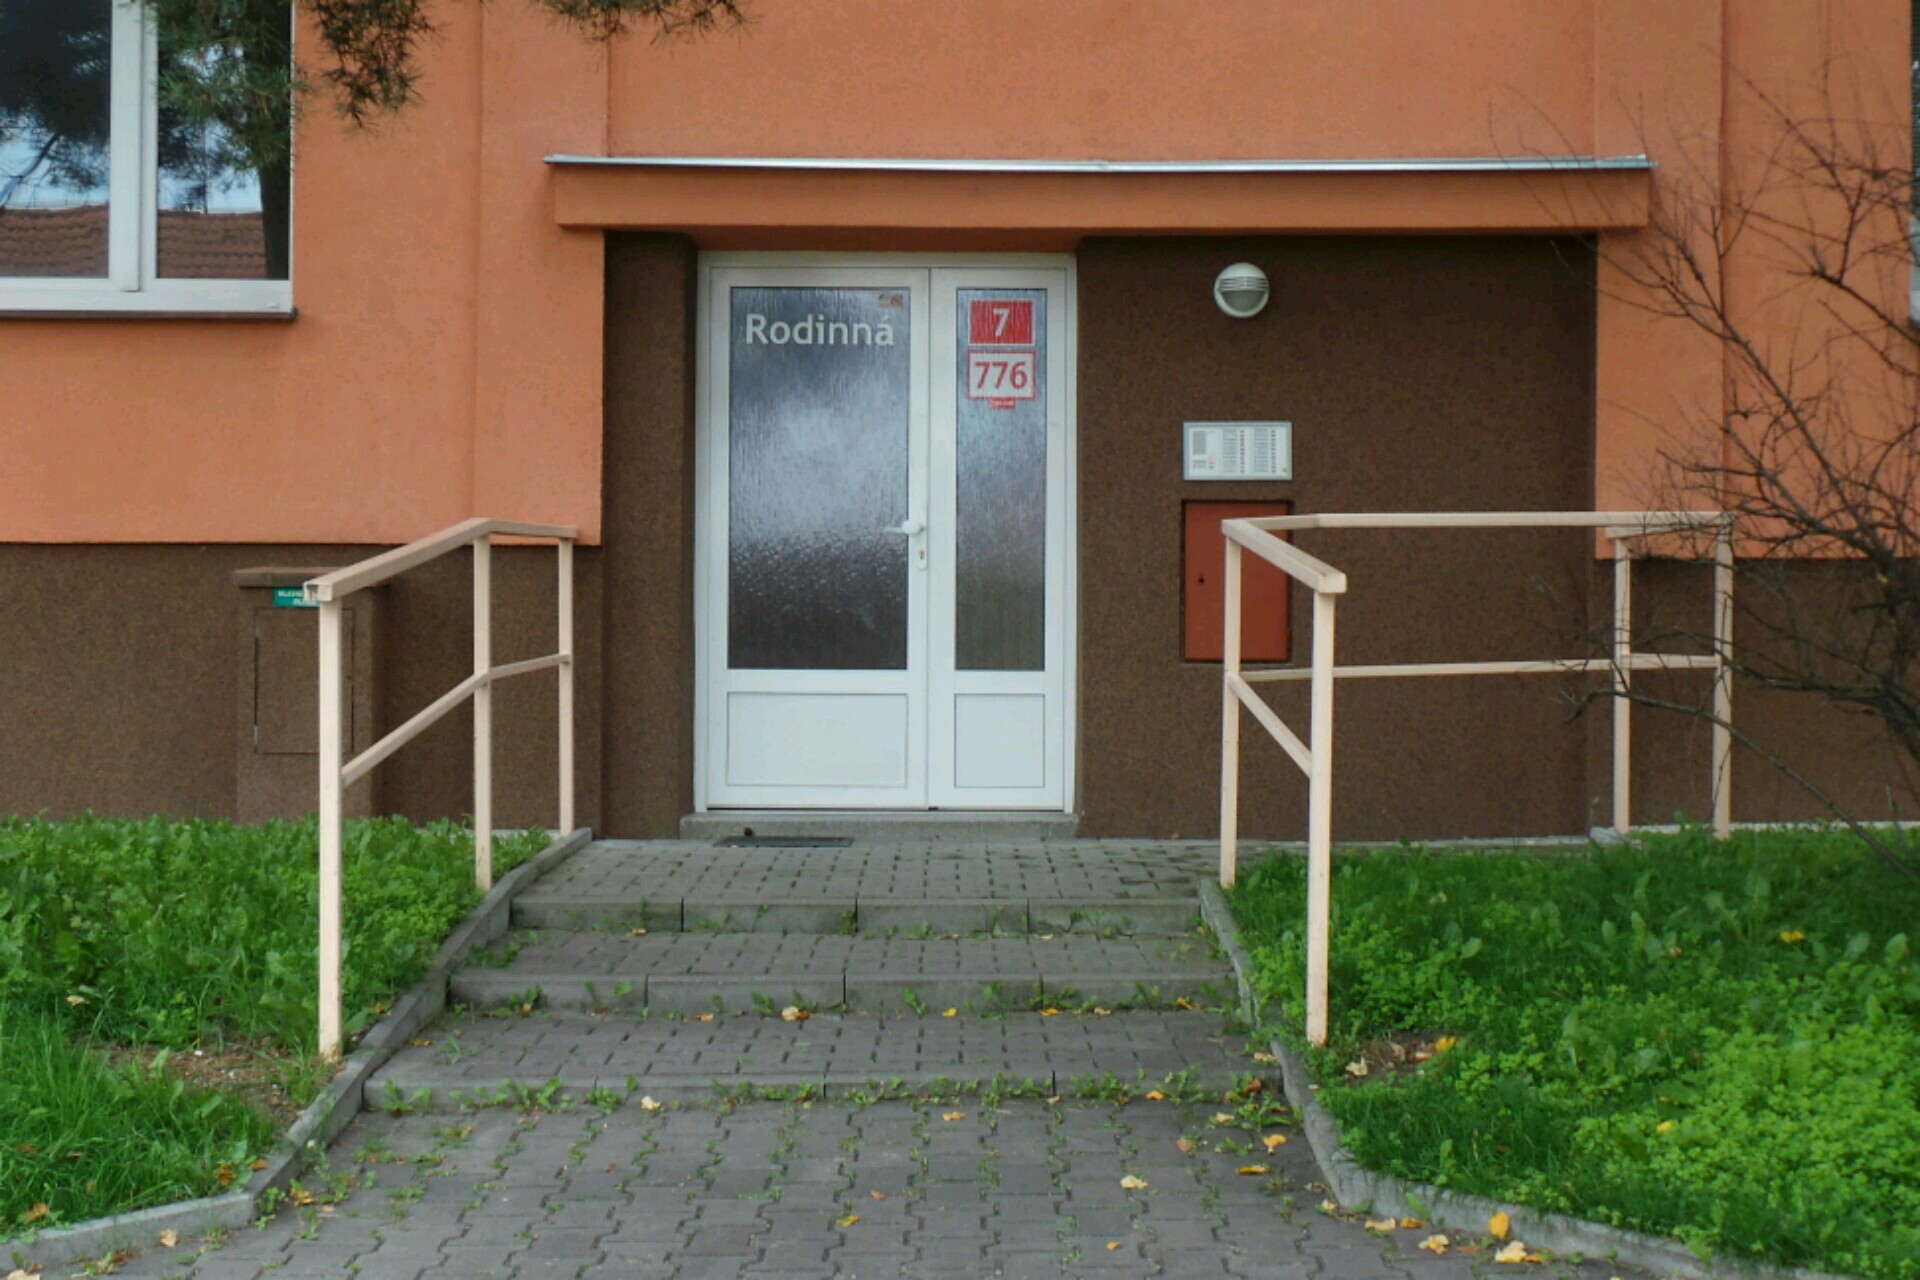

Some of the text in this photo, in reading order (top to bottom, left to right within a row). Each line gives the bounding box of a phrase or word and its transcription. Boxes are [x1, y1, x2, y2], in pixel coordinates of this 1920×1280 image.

[746, 312, 895, 346] Rodinná
[993, 307, 1010, 336] 7
[975, 361, 1028, 389] 776
